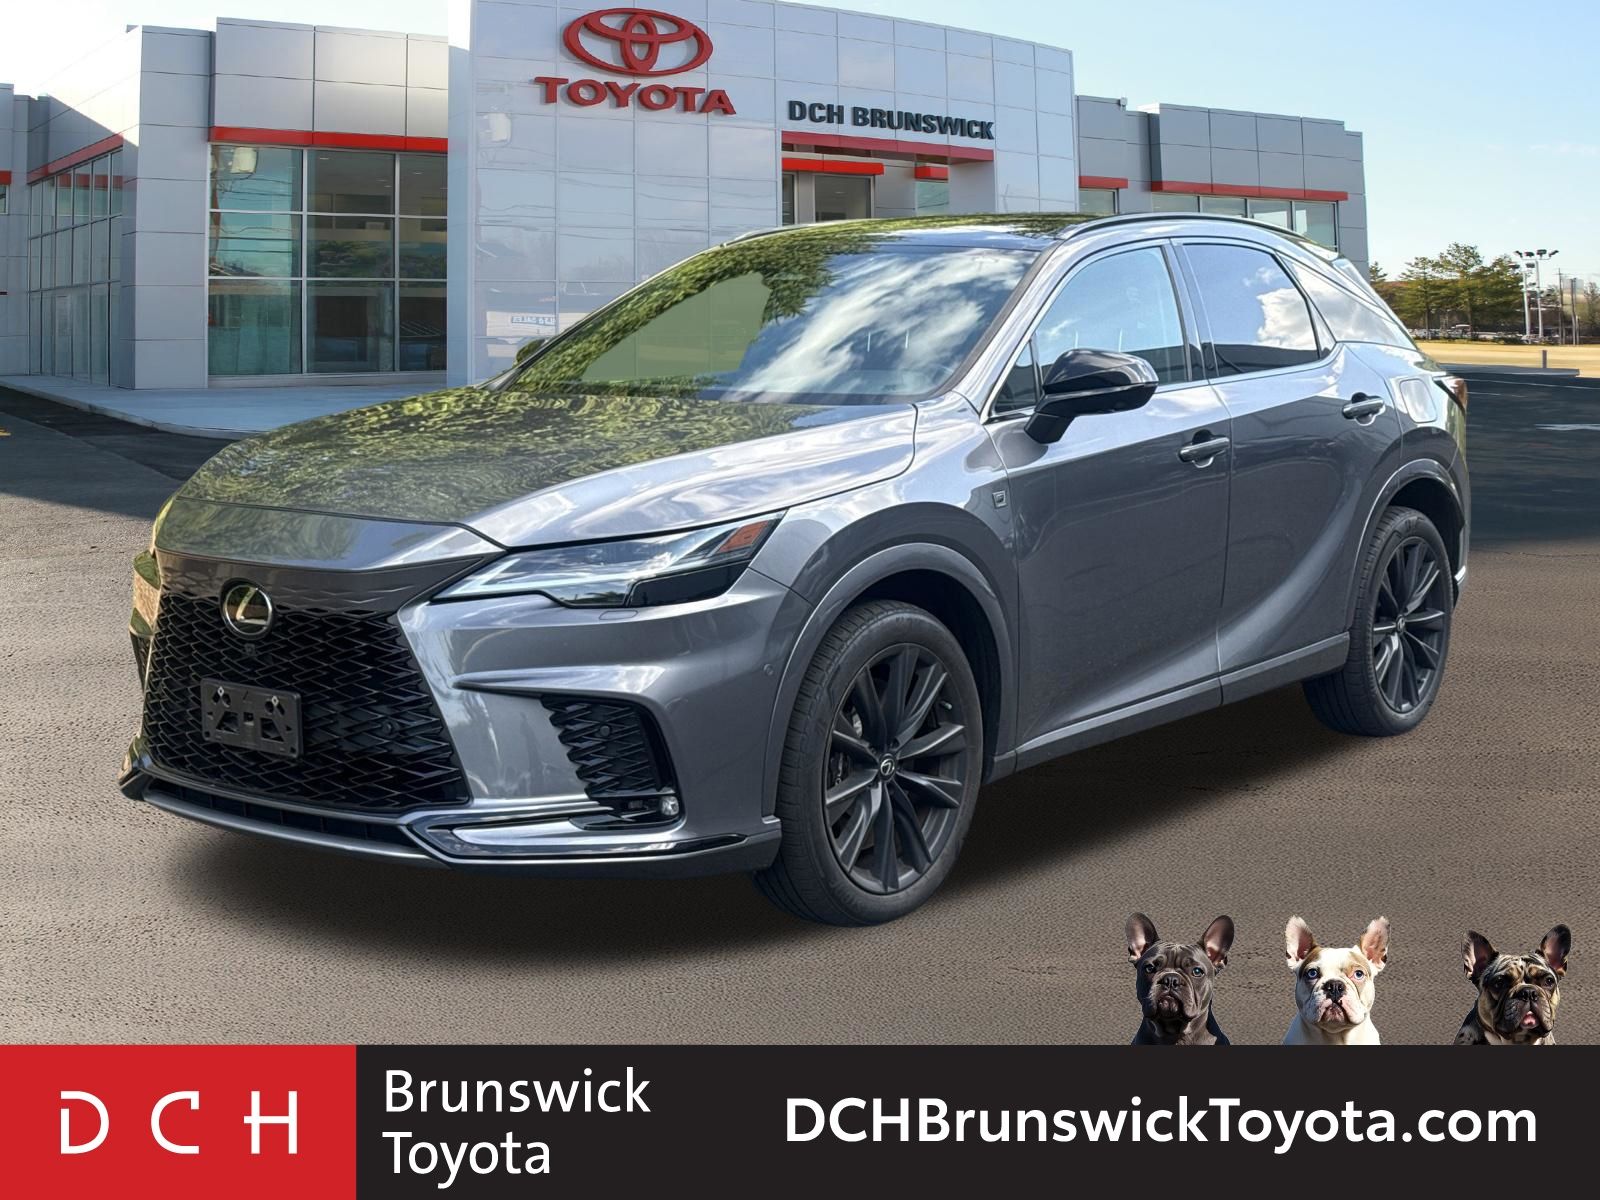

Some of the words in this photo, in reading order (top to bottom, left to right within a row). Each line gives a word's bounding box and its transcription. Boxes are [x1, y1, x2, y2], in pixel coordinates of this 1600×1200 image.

[534, 76, 736, 115] TOYOTA
[788, 100, 845, 126] DCH
[852, 106, 995, 141] BRUNSWICK
